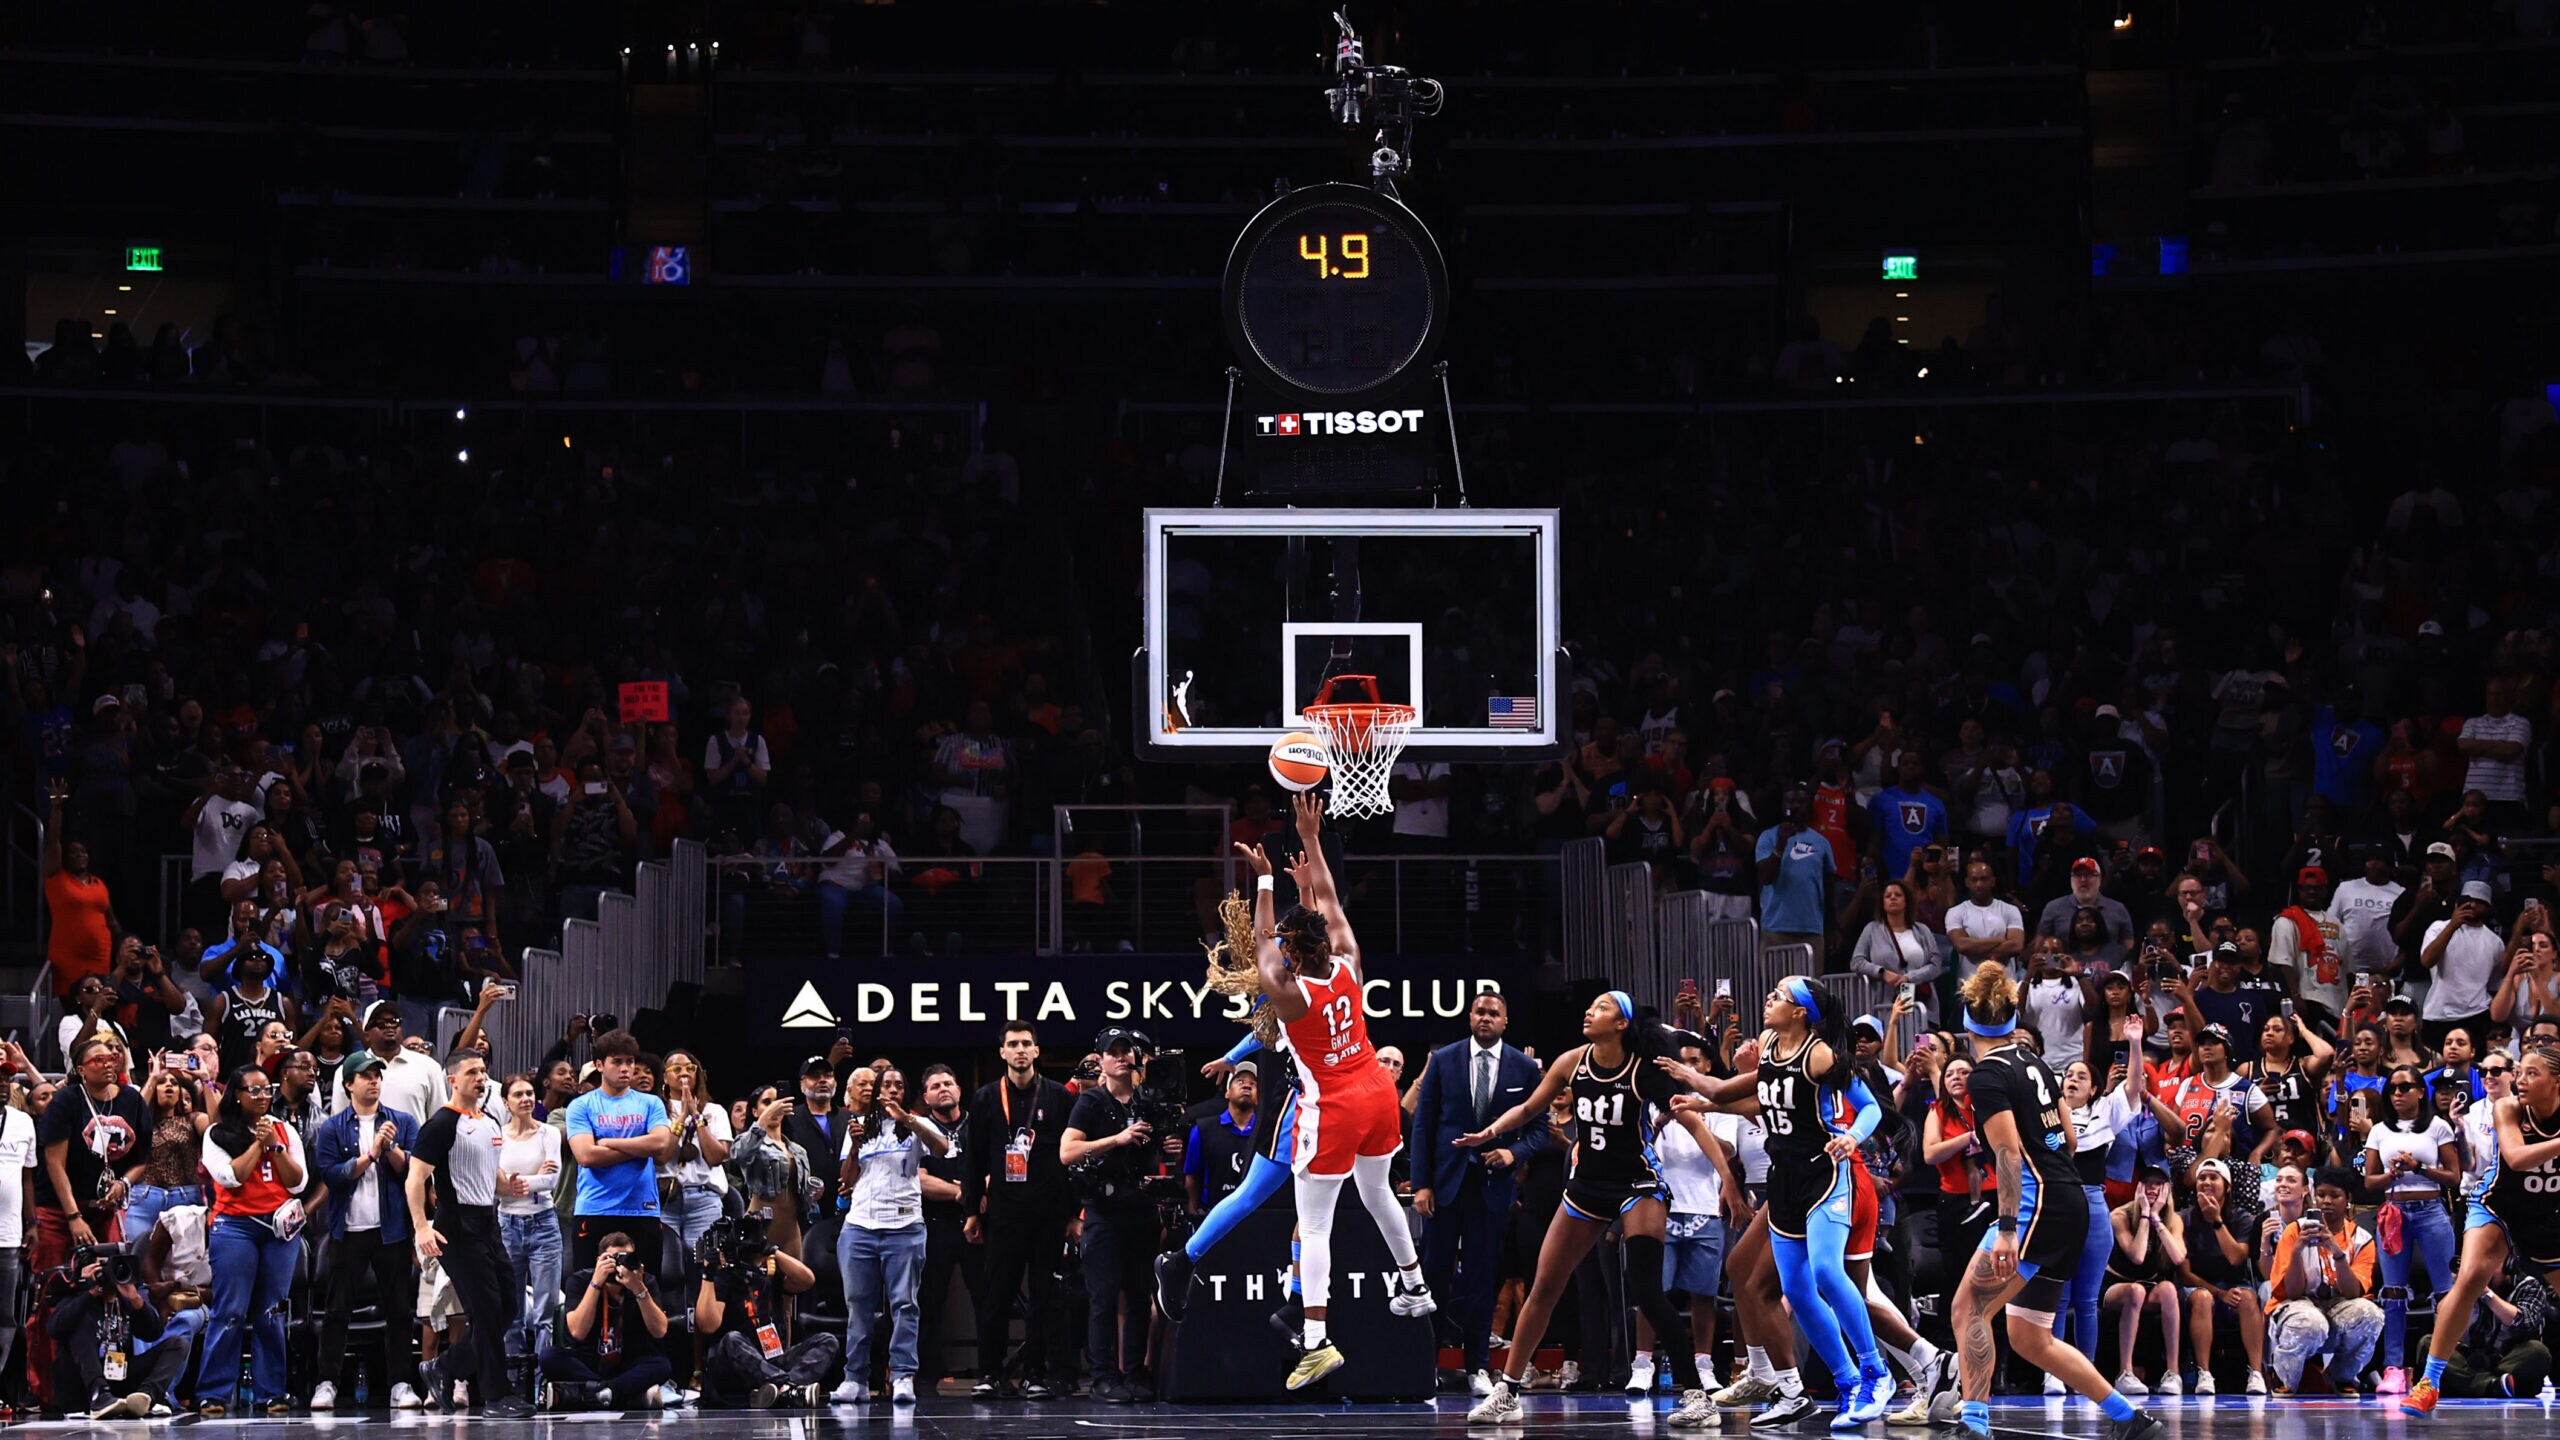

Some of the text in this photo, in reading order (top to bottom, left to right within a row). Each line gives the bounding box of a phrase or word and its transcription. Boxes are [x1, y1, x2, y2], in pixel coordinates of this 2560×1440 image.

[132, 248, 160, 267] EXIT
[1300, 233, 1370, 280] 4.9
[1302, 409, 1424, 435] TISSOT
[1288, 747, 1324, 762] Wilson
[1828, 810, 1838, 823] 2
[2306, 847, 2323, 867] 2
[2354, 897, 2393, 912] BOSS
[856, 981, 1077, 1023] DELTA
[234, 1008, 252, 1021] LAS
[1322, 995, 1355, 1036] 12
[1331, 1031, 1350, 1051] GRAY
[1339, 1042, 1362, 1062] AT&T
[2025, 1065, 2052, 1106] 2
[597, 1113, 643, 1126] ATLANTA
[1766, 1108, 1794, 1136] 15
[2274, 1104, 2289, 1121] 5
[1589, 1126, 1607, 1151] 5
[2523, 1174, 2560, 1194] 00
[1209, 1271, 1400, 1302] THTY
